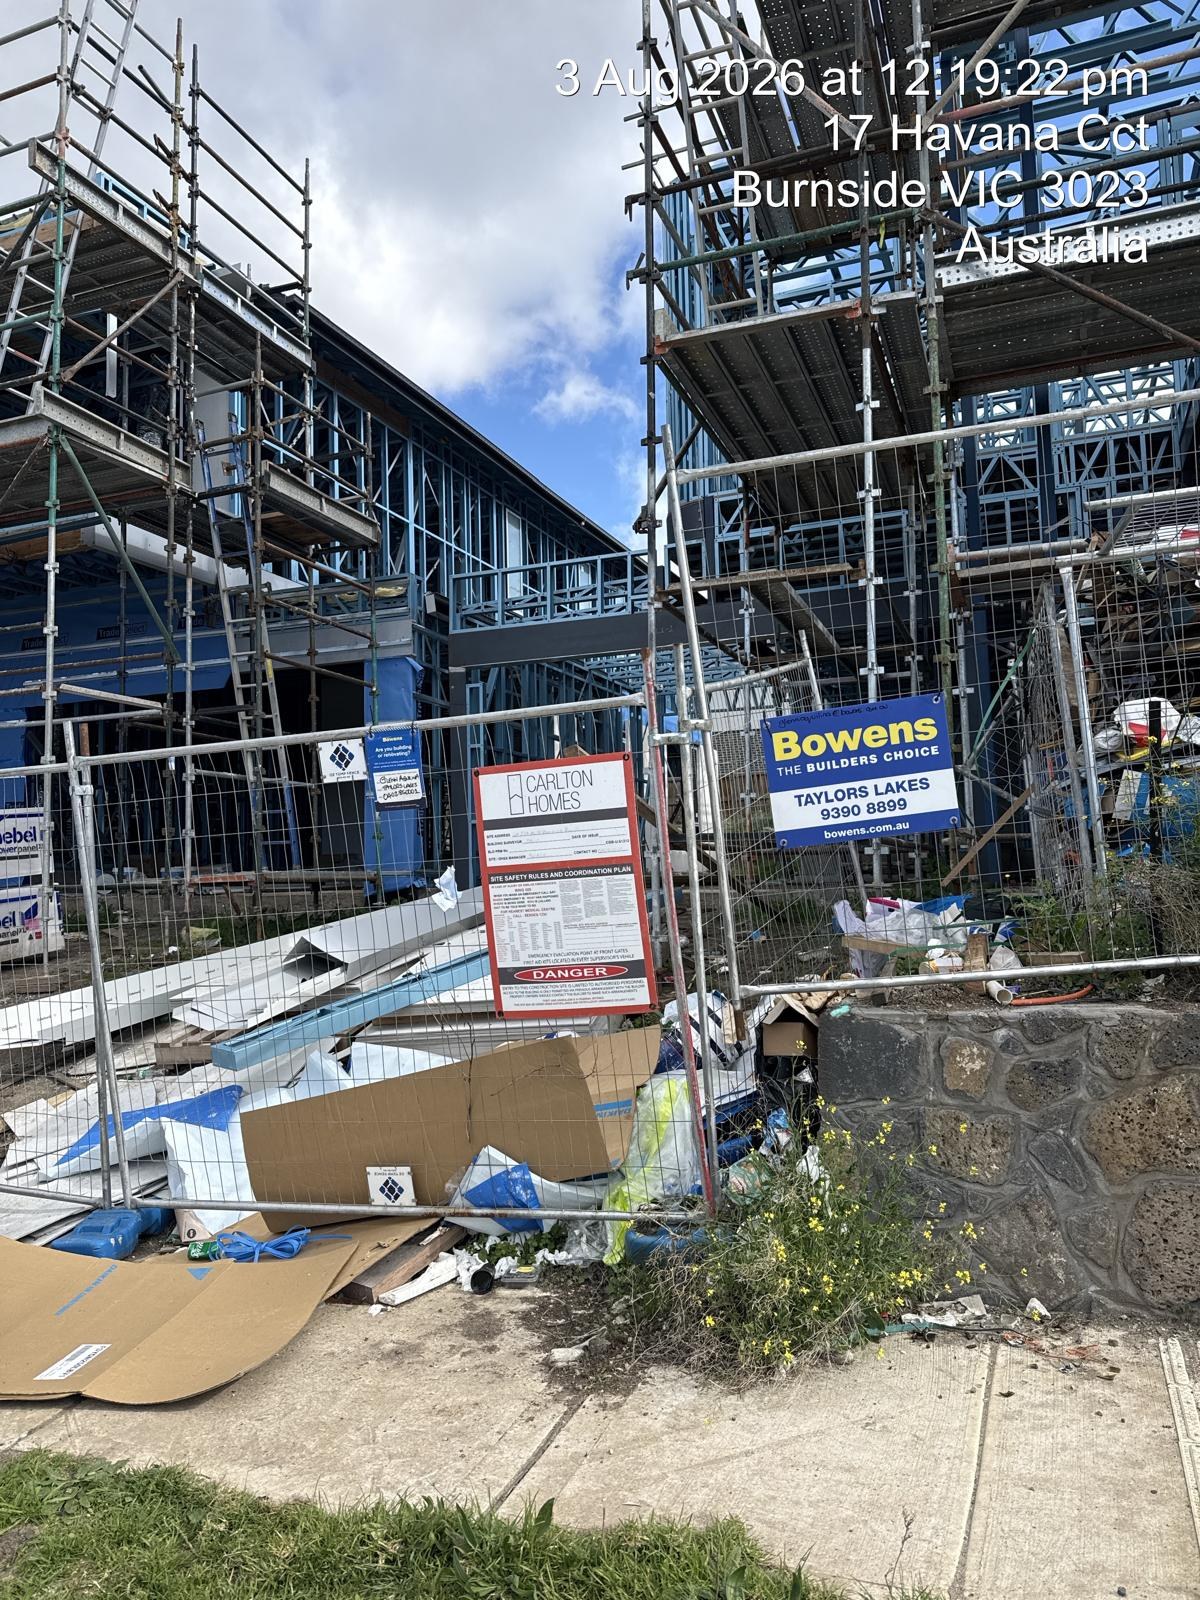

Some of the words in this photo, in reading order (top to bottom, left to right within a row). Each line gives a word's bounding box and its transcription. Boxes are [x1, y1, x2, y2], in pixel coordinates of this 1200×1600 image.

[772, 717, 938, 762] Bowens
[777, 764, 802, 776] THE
[807, 754, 878, 773] BUILDERS
[883, 745, 940, 762] CHOICE
[526, 769, 594, 793] CARLTON
[794, 785, 869, 807] TAYLORS
[874, 777, 930, 796] LAKES
[527, 791, 581, 814] HOMES
[821, 804, 860, 820] 9390
[867, 797, 907, 814] 8899
[0, 826, 37, 845] ebel
[824, 821, 909, 839] bowens.com.au
[490, 874, 504, 883] SITE
[504, 873, 528, 882] SAFETY
[528, 871, 549, 880] RULES
[550, 870, 564, 878] AND
[564, 868, 613, 877] COORDINATION
[613, 865, 632, 874] PLAN
[532, 967, 608, 980] DANGER
